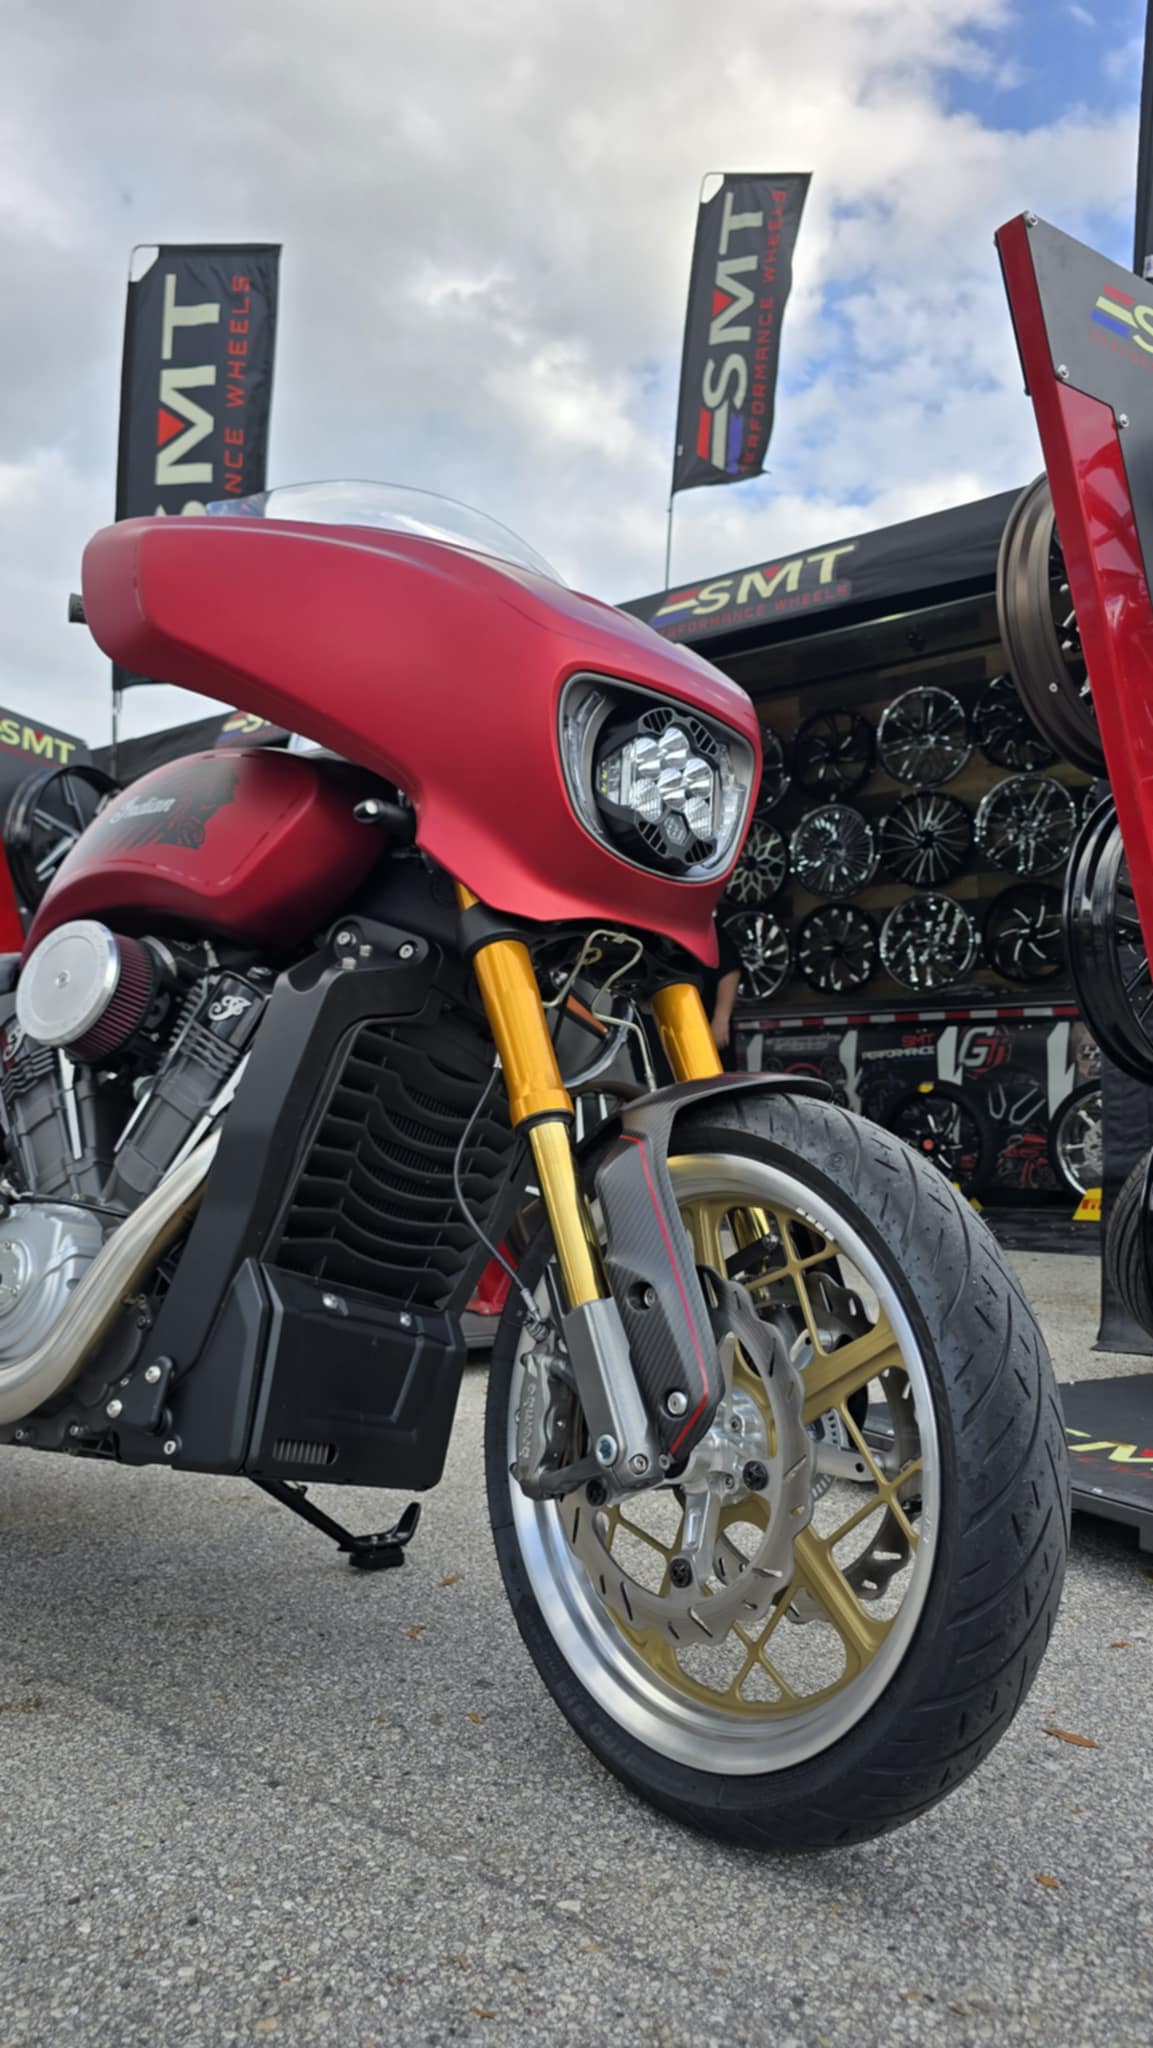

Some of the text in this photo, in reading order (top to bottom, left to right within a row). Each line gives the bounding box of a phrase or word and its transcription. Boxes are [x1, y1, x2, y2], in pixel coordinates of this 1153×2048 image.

[761, 190, 787, 283] WHEELS
[225, 275, 251, 408] WHEELS
[702, 191, 763, 411] SMT
[154, 273, 221, 517] MT
[691, 543, 856, 615] SMT
[0, 718, 77, 764] SMT
